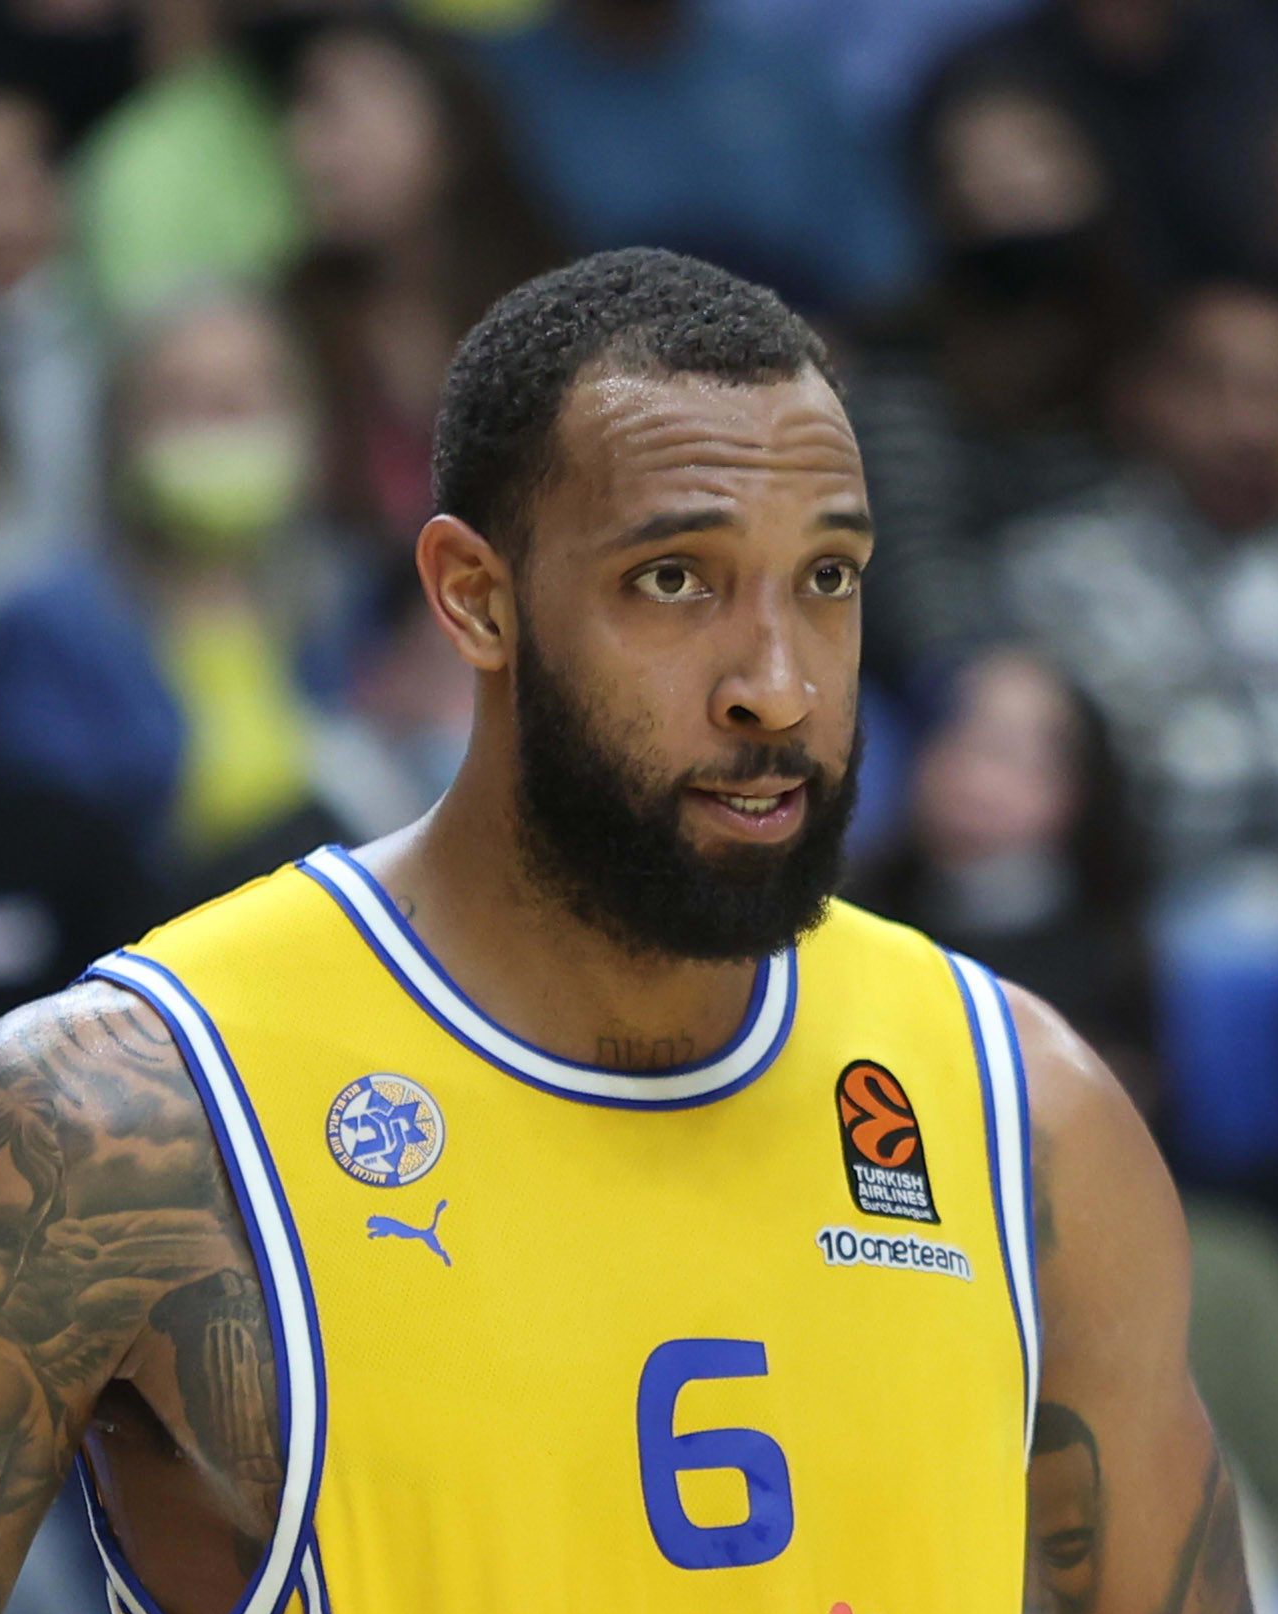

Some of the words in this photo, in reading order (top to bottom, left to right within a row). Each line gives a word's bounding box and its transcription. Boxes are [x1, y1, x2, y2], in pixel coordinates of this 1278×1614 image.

[350, 1163, 387, 1184] MACCABI
[853, 1164, 924, 1191] TURKISH
[858, 1182, 928, 1208] AIRLINES
[635, 1337, 795, 1571] 6
